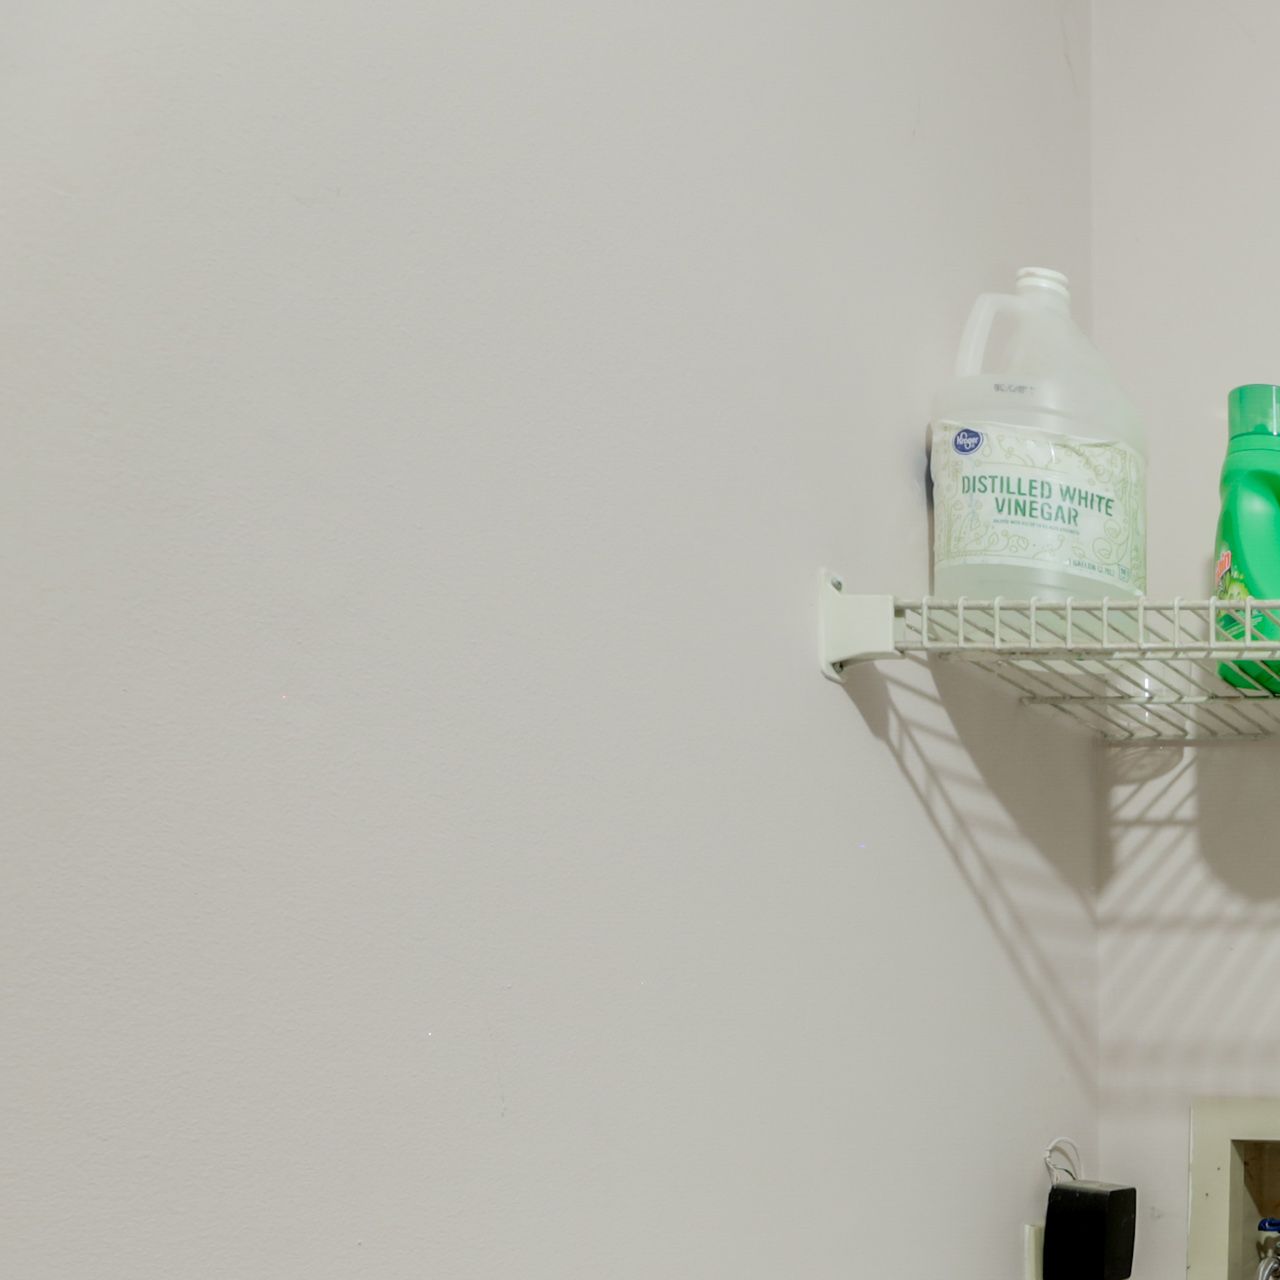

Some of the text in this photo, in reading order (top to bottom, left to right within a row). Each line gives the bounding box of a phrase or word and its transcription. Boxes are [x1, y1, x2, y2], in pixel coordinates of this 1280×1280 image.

[956, 432, 979, 449] Kroger
[961, 475, 1115, 517] DISTILLED WHITE
[995, 498, 1080, 526] VINEGAR
